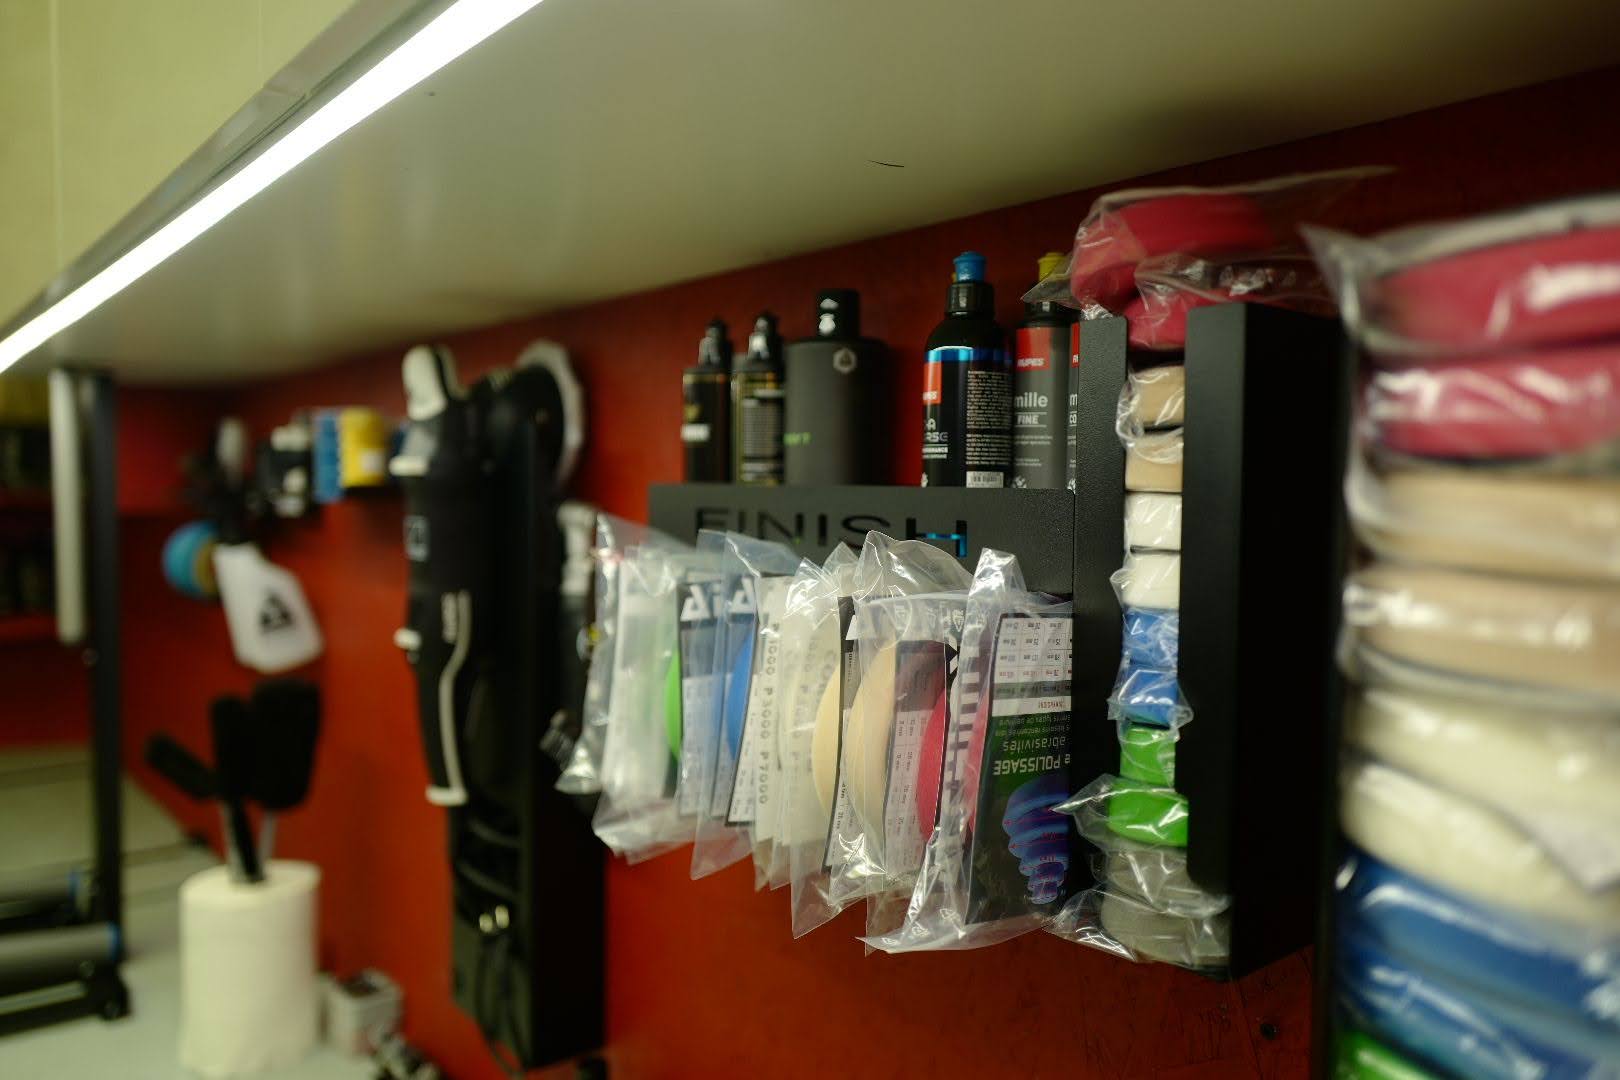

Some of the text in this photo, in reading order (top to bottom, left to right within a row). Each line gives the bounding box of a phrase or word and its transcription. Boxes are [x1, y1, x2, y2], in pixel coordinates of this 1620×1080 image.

[1014, 391, 1049, 408] mille
[1017, 414, 1040, 424] FINE
[694, 507, 968, 559] FINISH
[992, 755, 1061, 776] POLISSAGE
